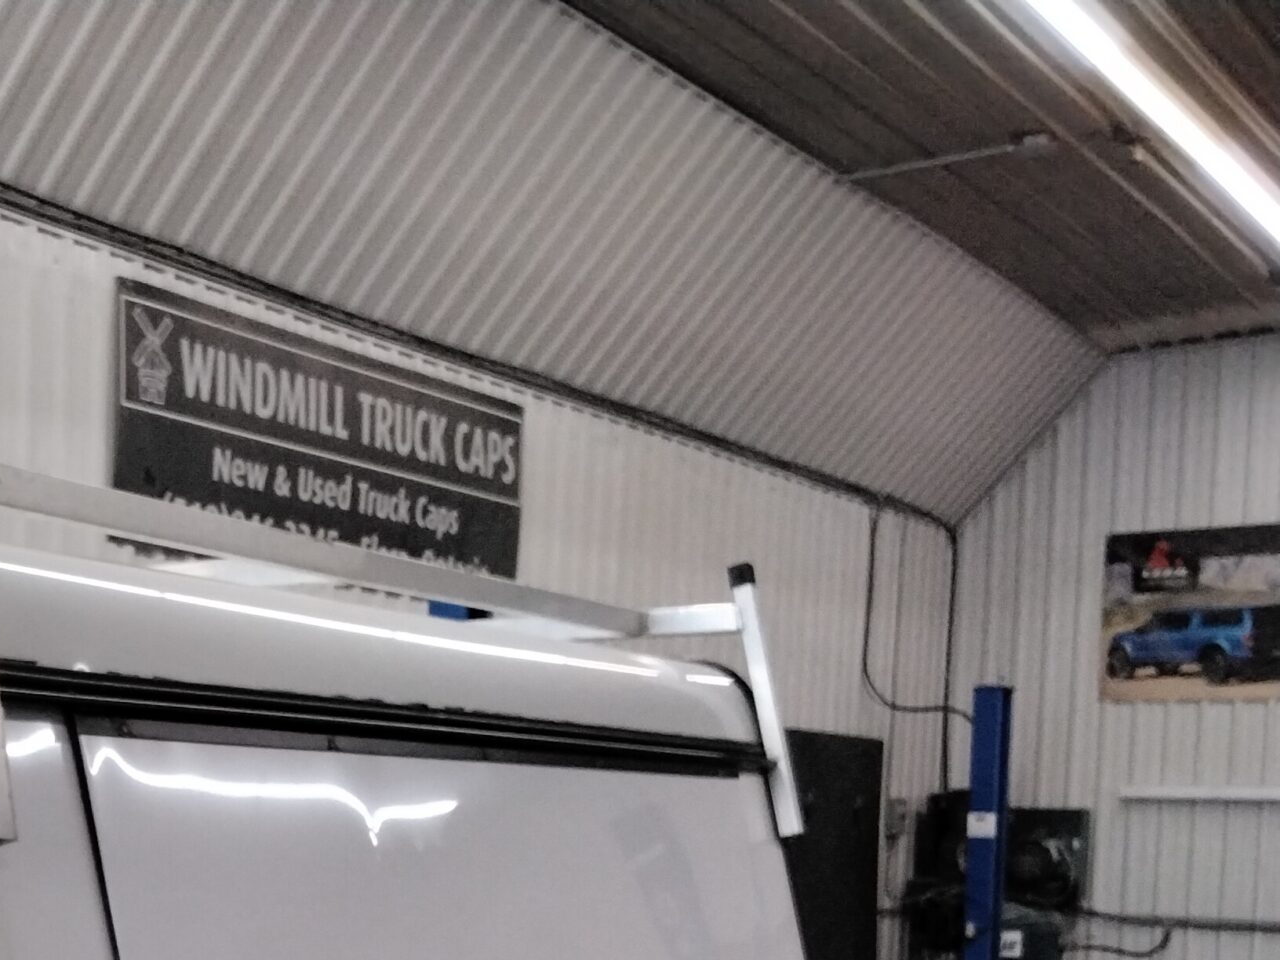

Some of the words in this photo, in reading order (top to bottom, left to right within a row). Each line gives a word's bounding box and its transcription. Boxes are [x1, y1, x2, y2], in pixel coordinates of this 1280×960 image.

[180, 337, 349, 441] WINDMILL
[357, 391, 447, 466] TRUCK
[454, 421, 516, 485] CAPS
[212, 447, 269, 492] New
[273, 464, 292, 498] &
[297, 467, 353, 511] Used
[357, 481, 411, 526] Truck
[415, 496, 461, 541] Caps
